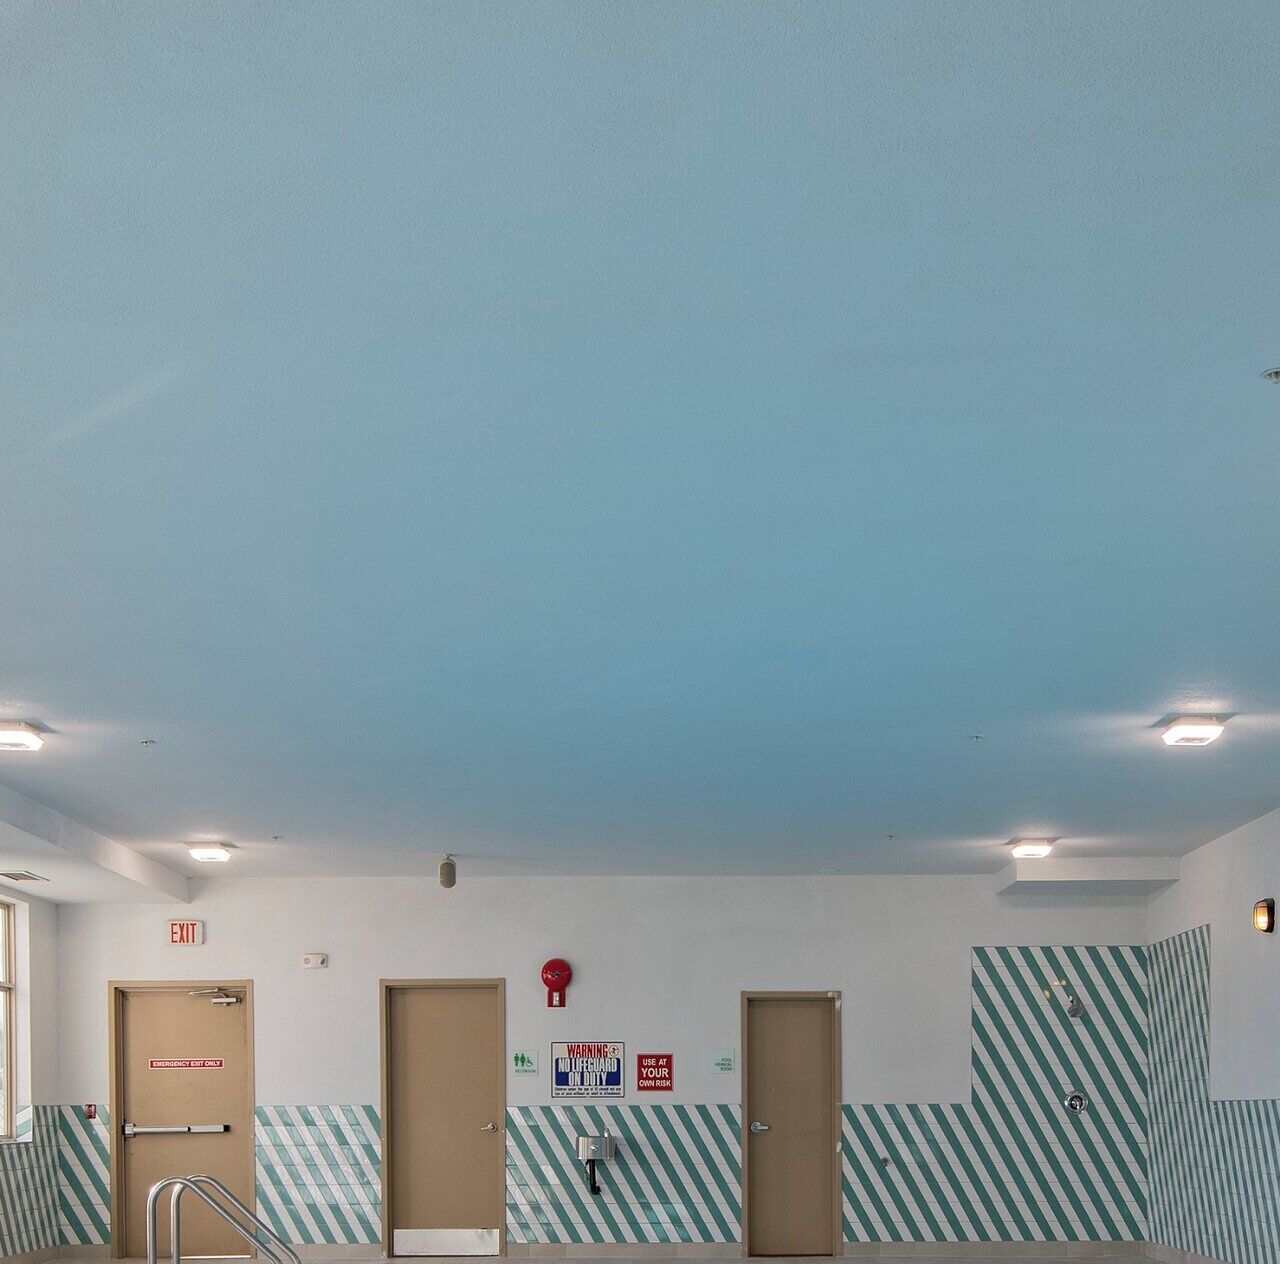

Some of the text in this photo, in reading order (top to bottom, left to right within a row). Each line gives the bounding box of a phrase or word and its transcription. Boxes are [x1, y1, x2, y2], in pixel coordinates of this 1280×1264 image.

[171, 923, 196, 943] EXIT
[567, 1044, 608, 1058] WARNING
[558, 1058, 617, 1072] NO LIFEGUARD
[568, 1072, 607, 1086] ON DUTY
[641, 1068, 669, 1078] YOUR
[656, 1079, 671, 1087] RISK
